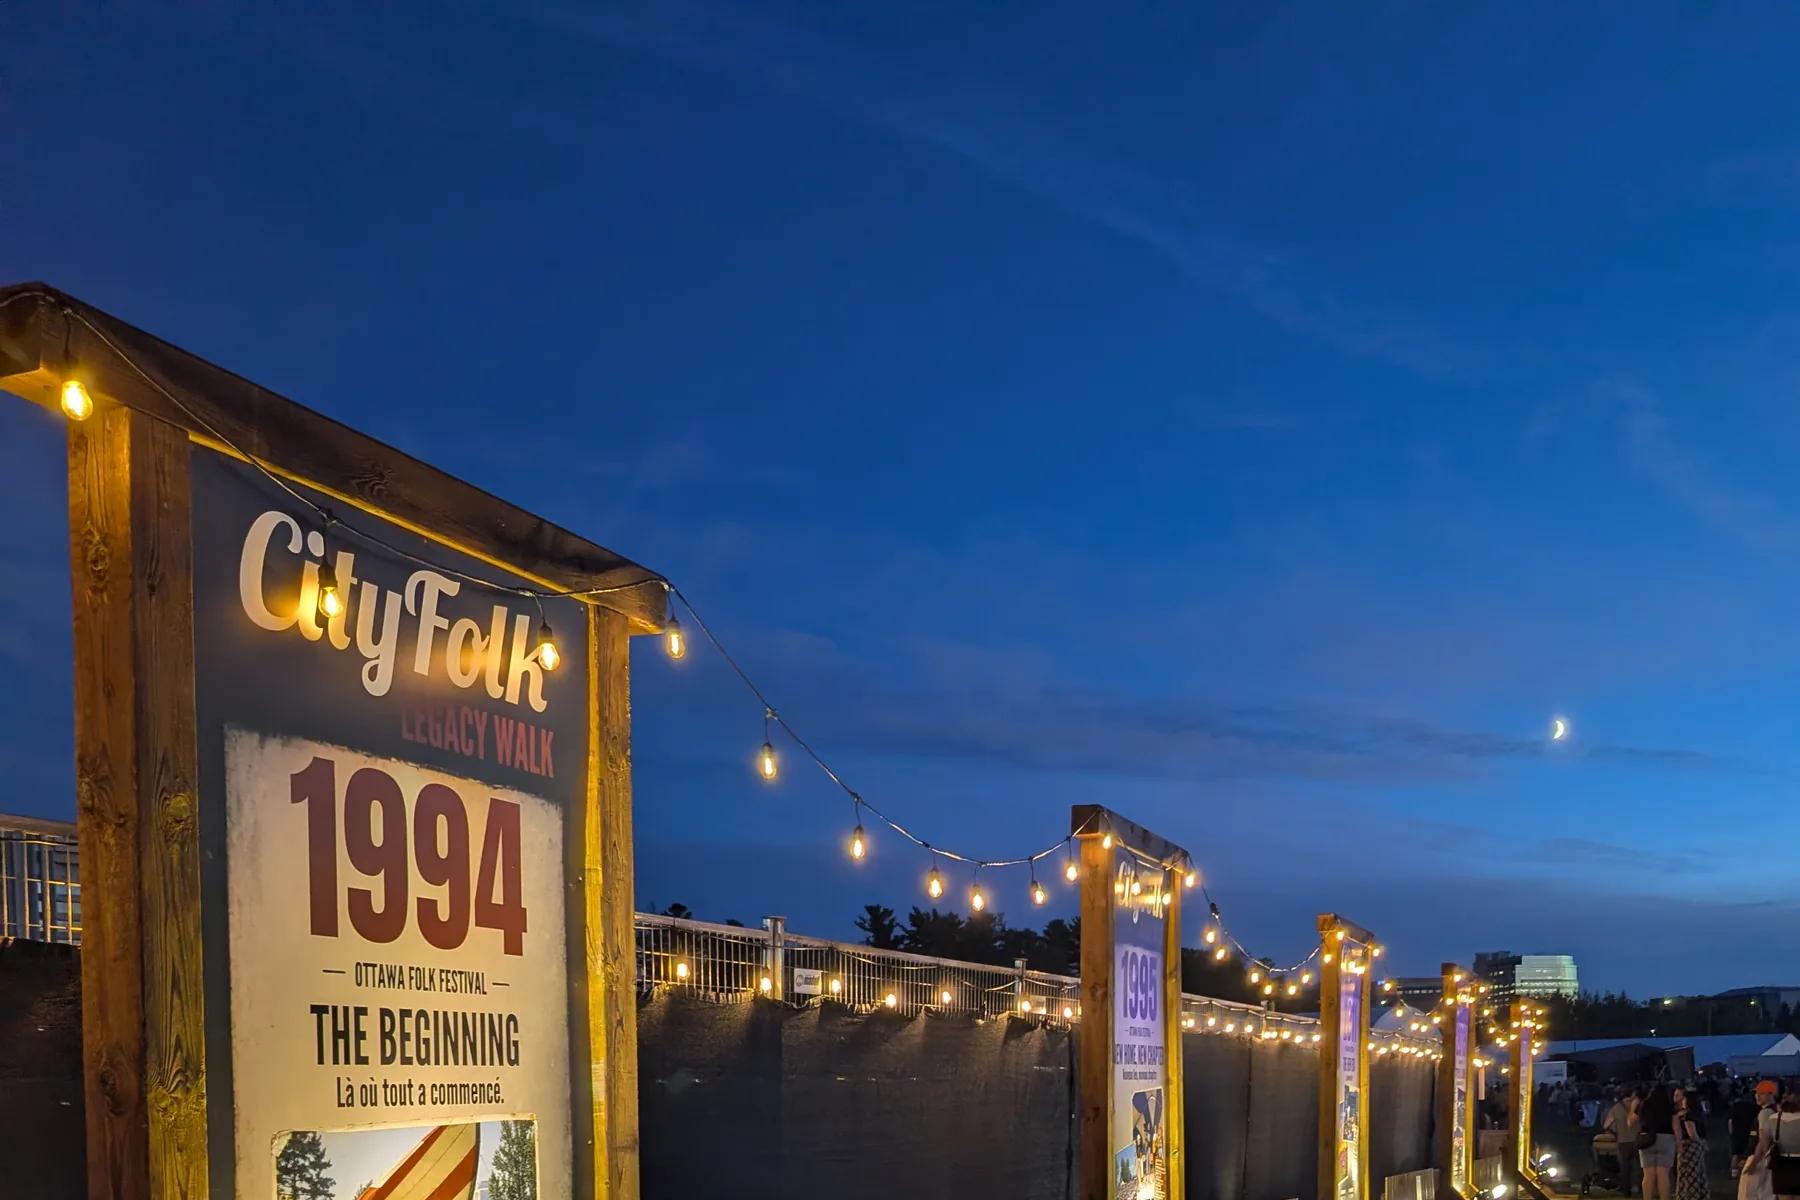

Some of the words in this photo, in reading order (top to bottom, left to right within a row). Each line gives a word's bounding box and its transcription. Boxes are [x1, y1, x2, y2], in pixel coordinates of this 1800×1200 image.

[239, 510, 548, 713] CityFolk
[401, 702, 487, 760] LEGACY
[493, 714, 554, 778] WALK
[290, 756, 528, 957] 1994
[355, 961, 406, 990] OTTAWA
[408, 966, 437, 992] FOLK
[439, 968, 488, 996] FESTIVAL
[1121, 950, 1157, 1021] 1995
[310, 1004, 370, 1066] THE
[379, 1007, 520, 1067] BEGINNING
[337, 1076, 355, 1108] Là
[360, 1076, 378, 1106] où
[382, 1078, 416, 1106] tout
[418, 1084, 426, 1106] a
[430, 1077, 505, 1106] commencé.
